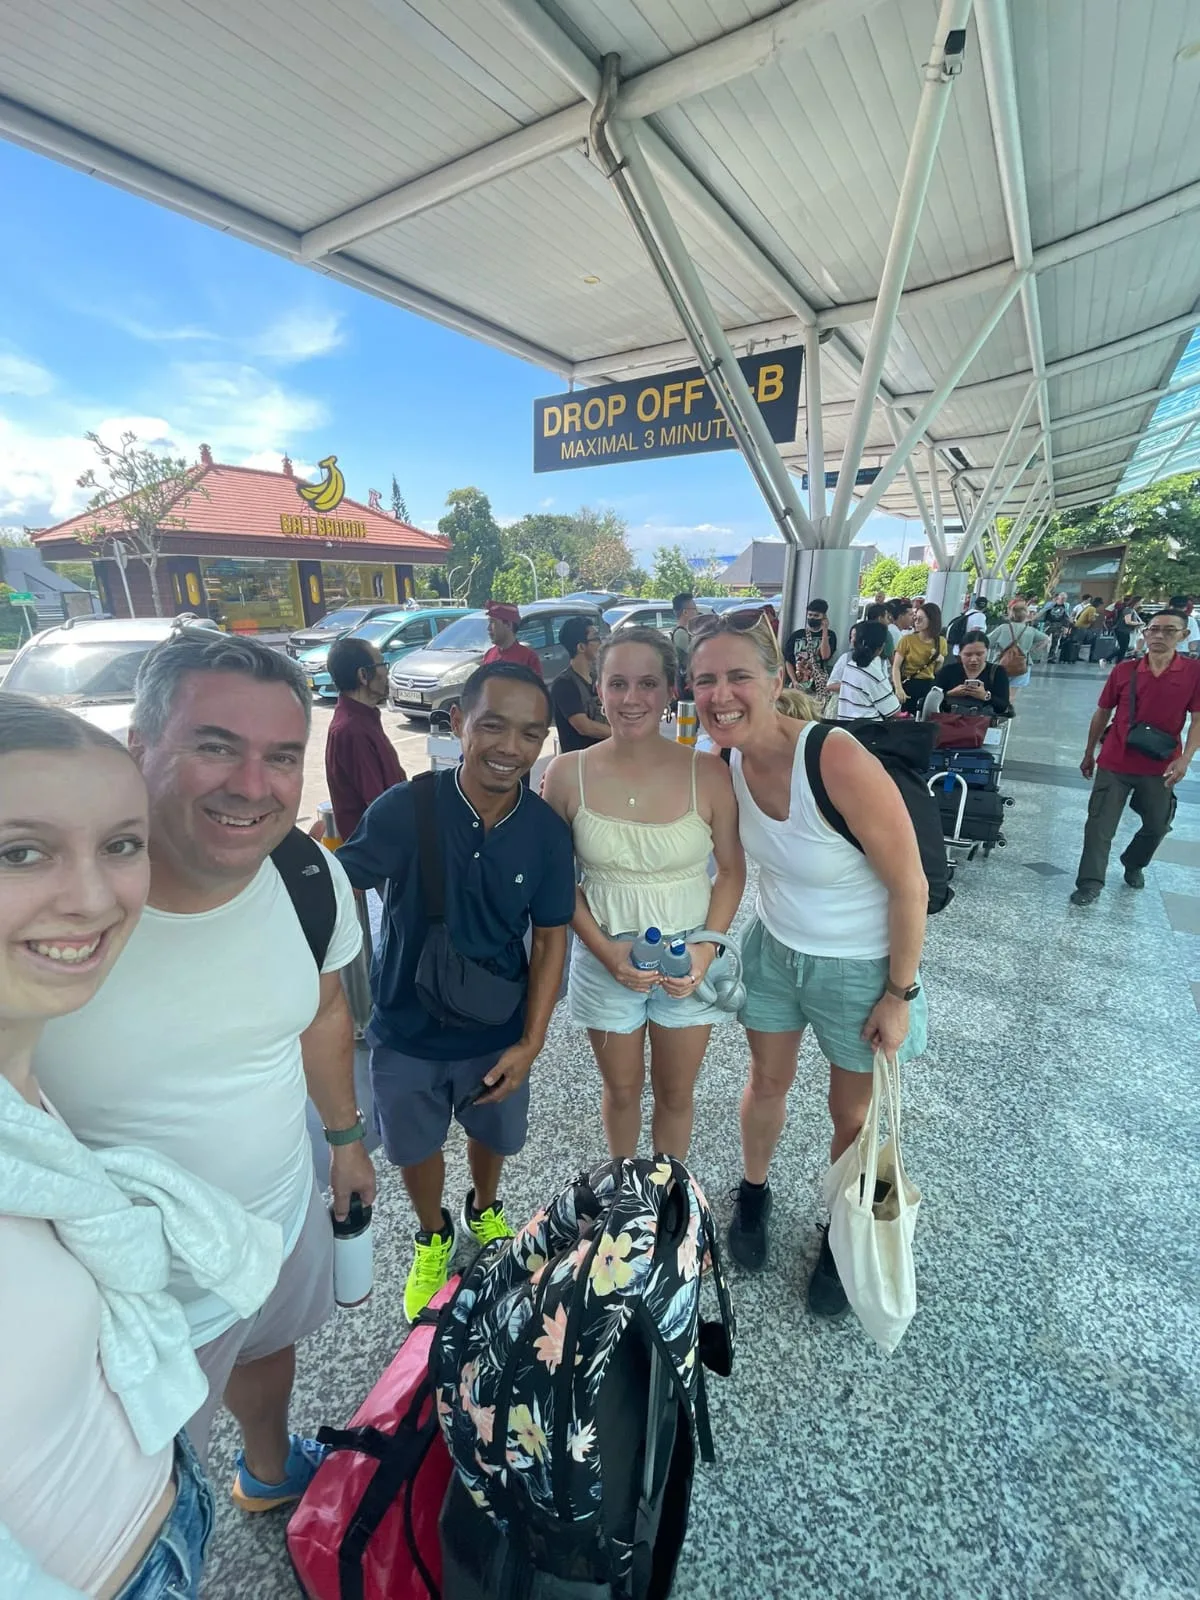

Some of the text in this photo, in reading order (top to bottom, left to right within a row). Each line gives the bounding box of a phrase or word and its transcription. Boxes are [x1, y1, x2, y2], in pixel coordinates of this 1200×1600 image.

[543, 394, 627, 437] DROP
[636, 378, 706, 423] OFF
[561, 418, 736, 461] MAXIMAL 3 MINUT
[280, 513, 367, 538] BALI BANANA
